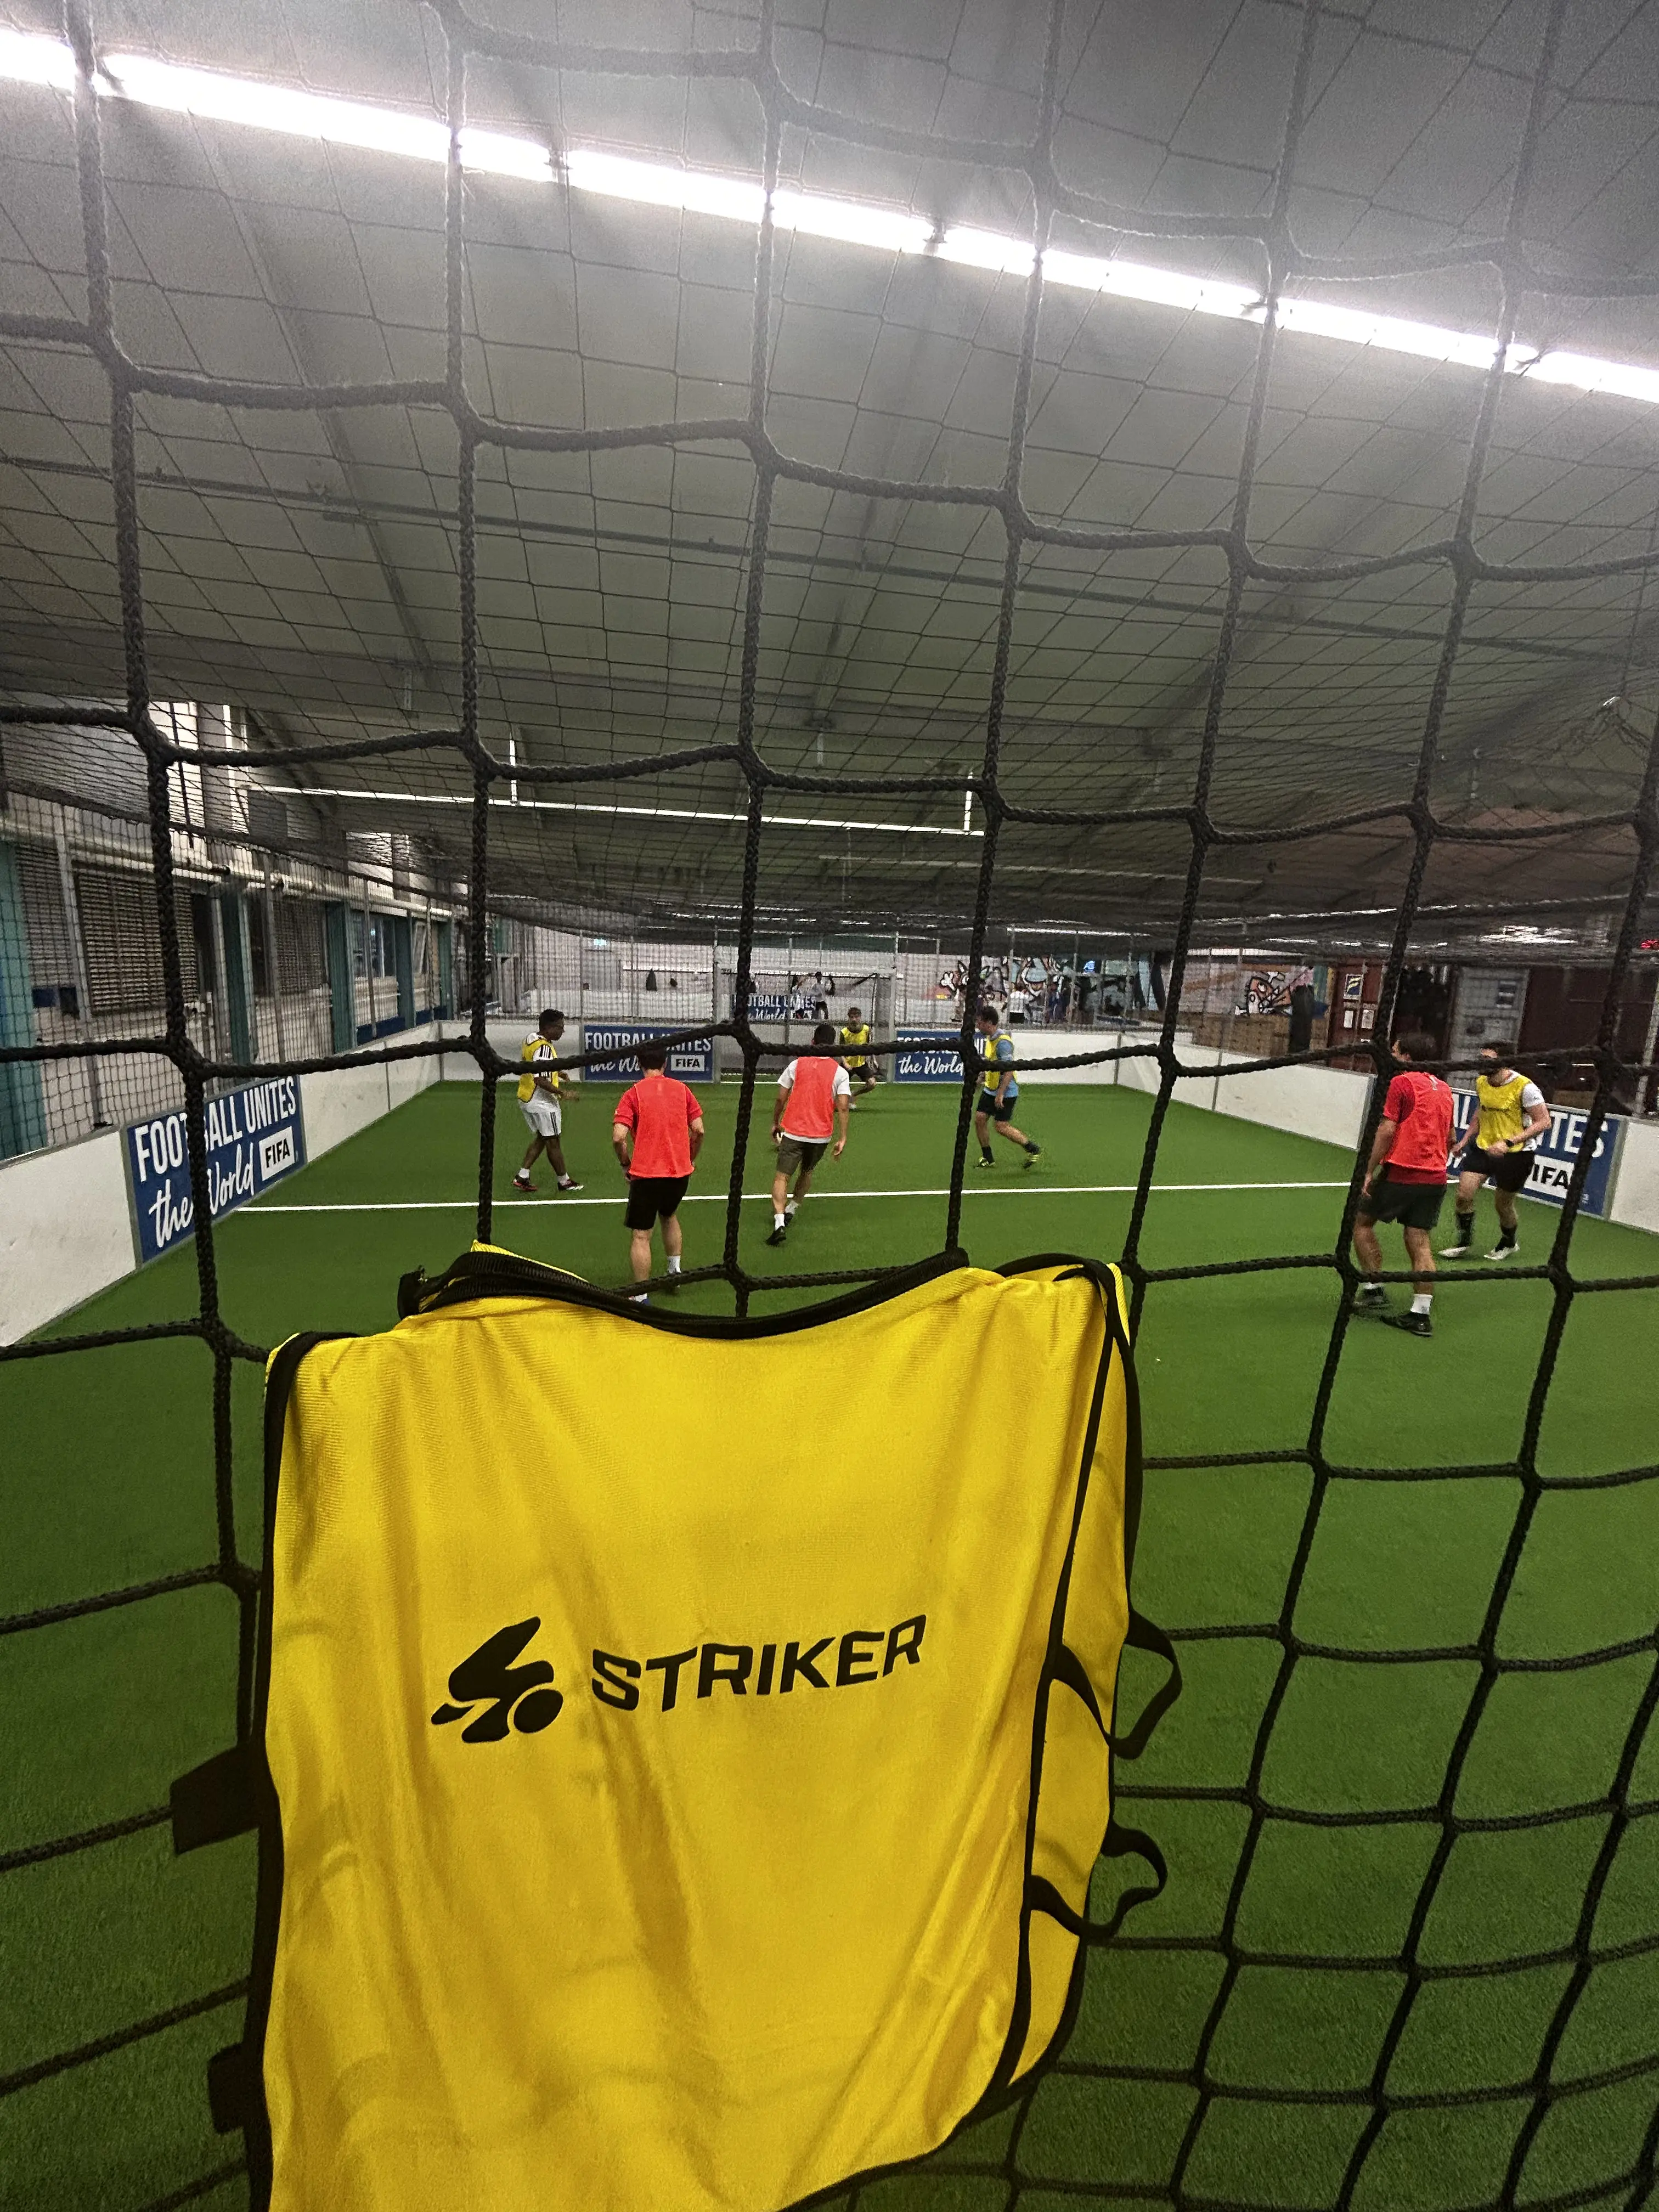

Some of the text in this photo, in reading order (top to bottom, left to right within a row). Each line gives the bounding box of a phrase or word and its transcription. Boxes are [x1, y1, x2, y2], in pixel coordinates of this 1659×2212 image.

[585, 1032, 653, 1050] FOOTBA
[676, 1059, 700, 1068] FIFA
[898, 1055, 922, 1074] the
[135, 1076, 297, 1182] FOOALL UNITES
[265, 1138, 291, 1169] FIFA
[1532, 1164, 1568, 1189] IFA
[149, 1179, 194, 1248] the
[591, 1614, 927, 1713] STRIKER
